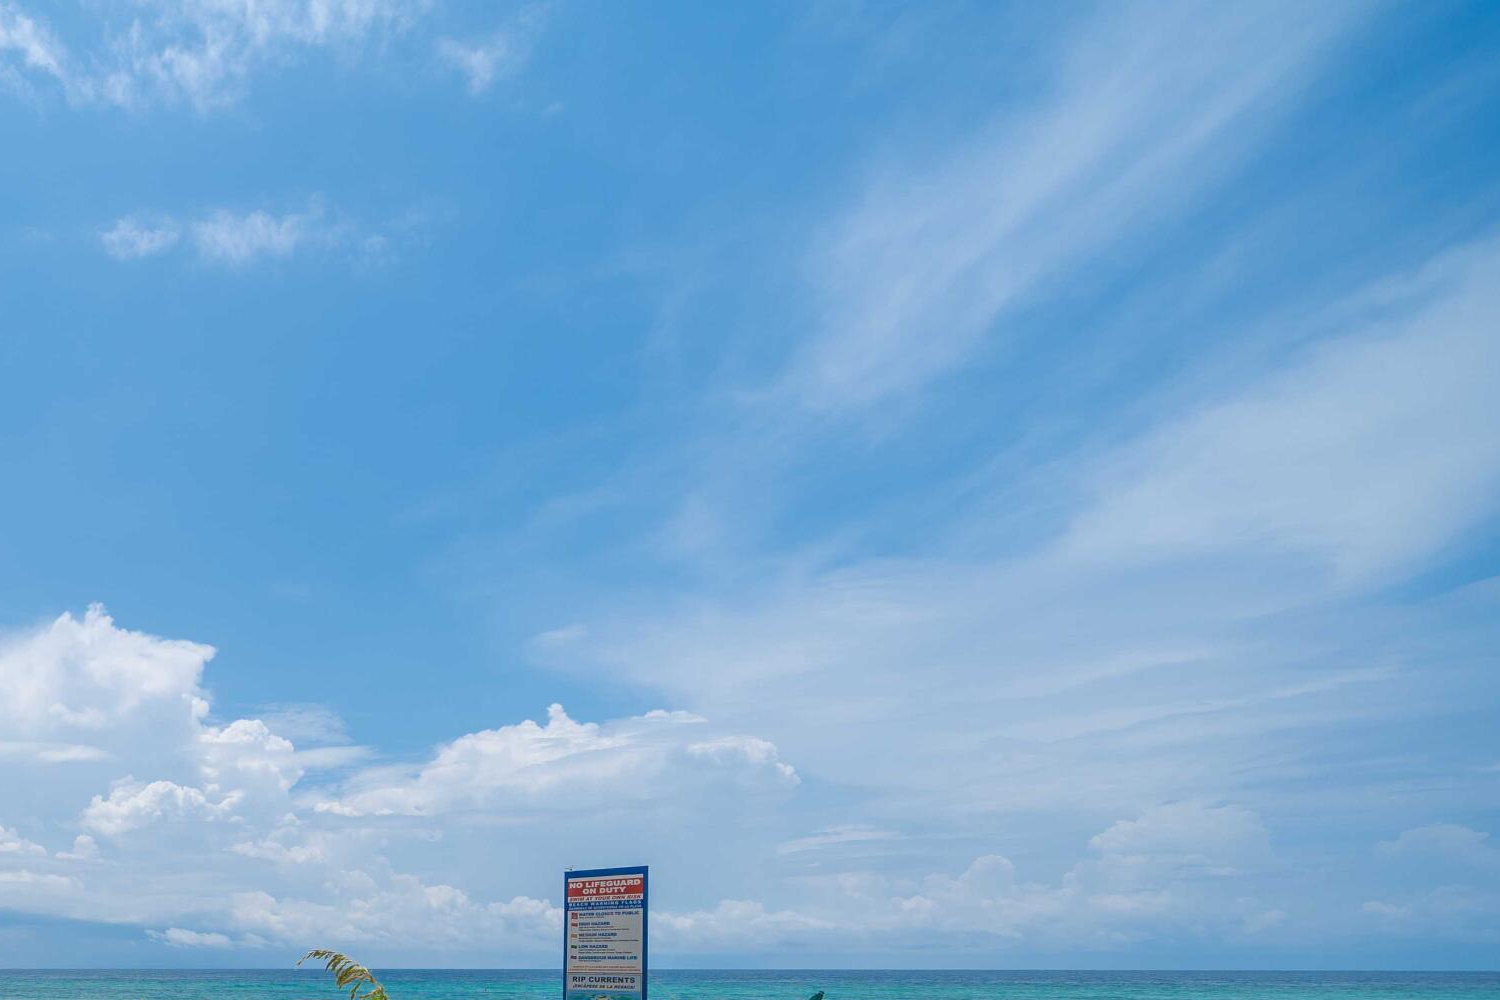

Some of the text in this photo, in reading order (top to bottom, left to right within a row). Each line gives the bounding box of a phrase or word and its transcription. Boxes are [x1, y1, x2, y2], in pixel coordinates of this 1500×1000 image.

[586, 879, 641, 888] LIFEGUARD
[599, 886, 626, 894] DUTY
[588, 976, 635, 984] CURRENTS
